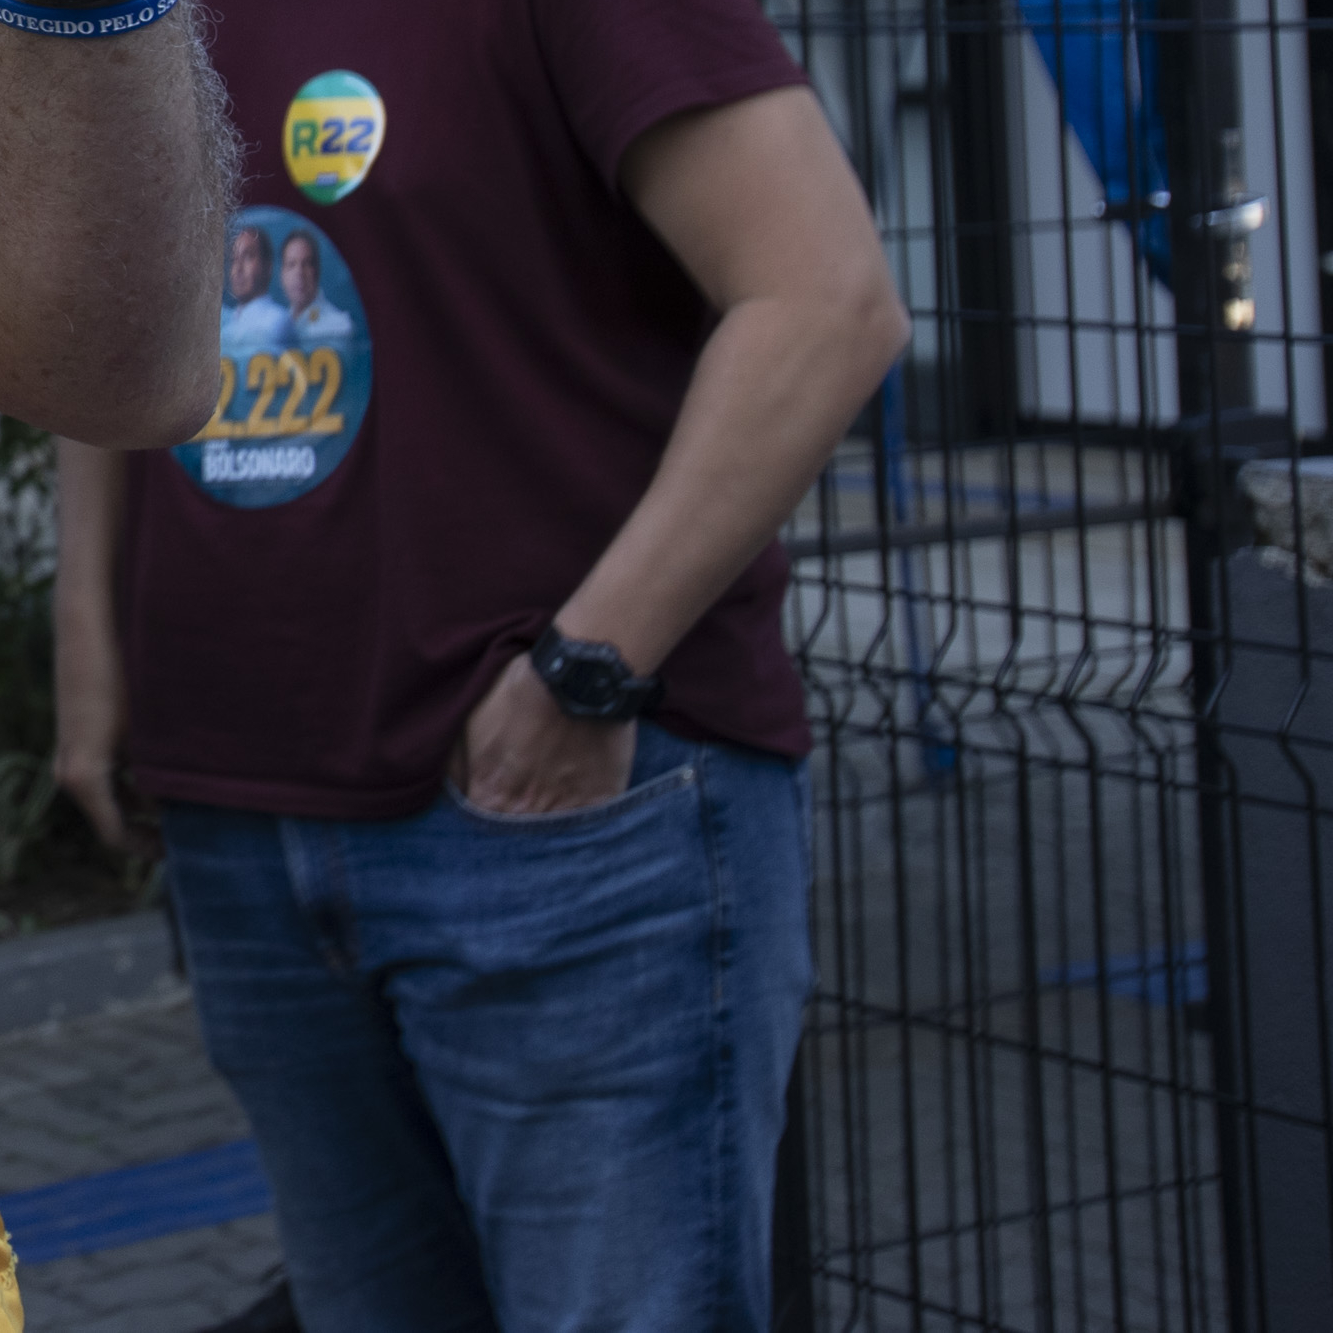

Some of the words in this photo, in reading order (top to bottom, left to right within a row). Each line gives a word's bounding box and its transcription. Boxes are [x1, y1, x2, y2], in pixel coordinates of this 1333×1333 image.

[99, 7, 155, 33] PELO
[290, 116, 377, 158] R22
[188, 346, 345, 442] 2.222
[201, 445, 316, 484] BOLSONARO
